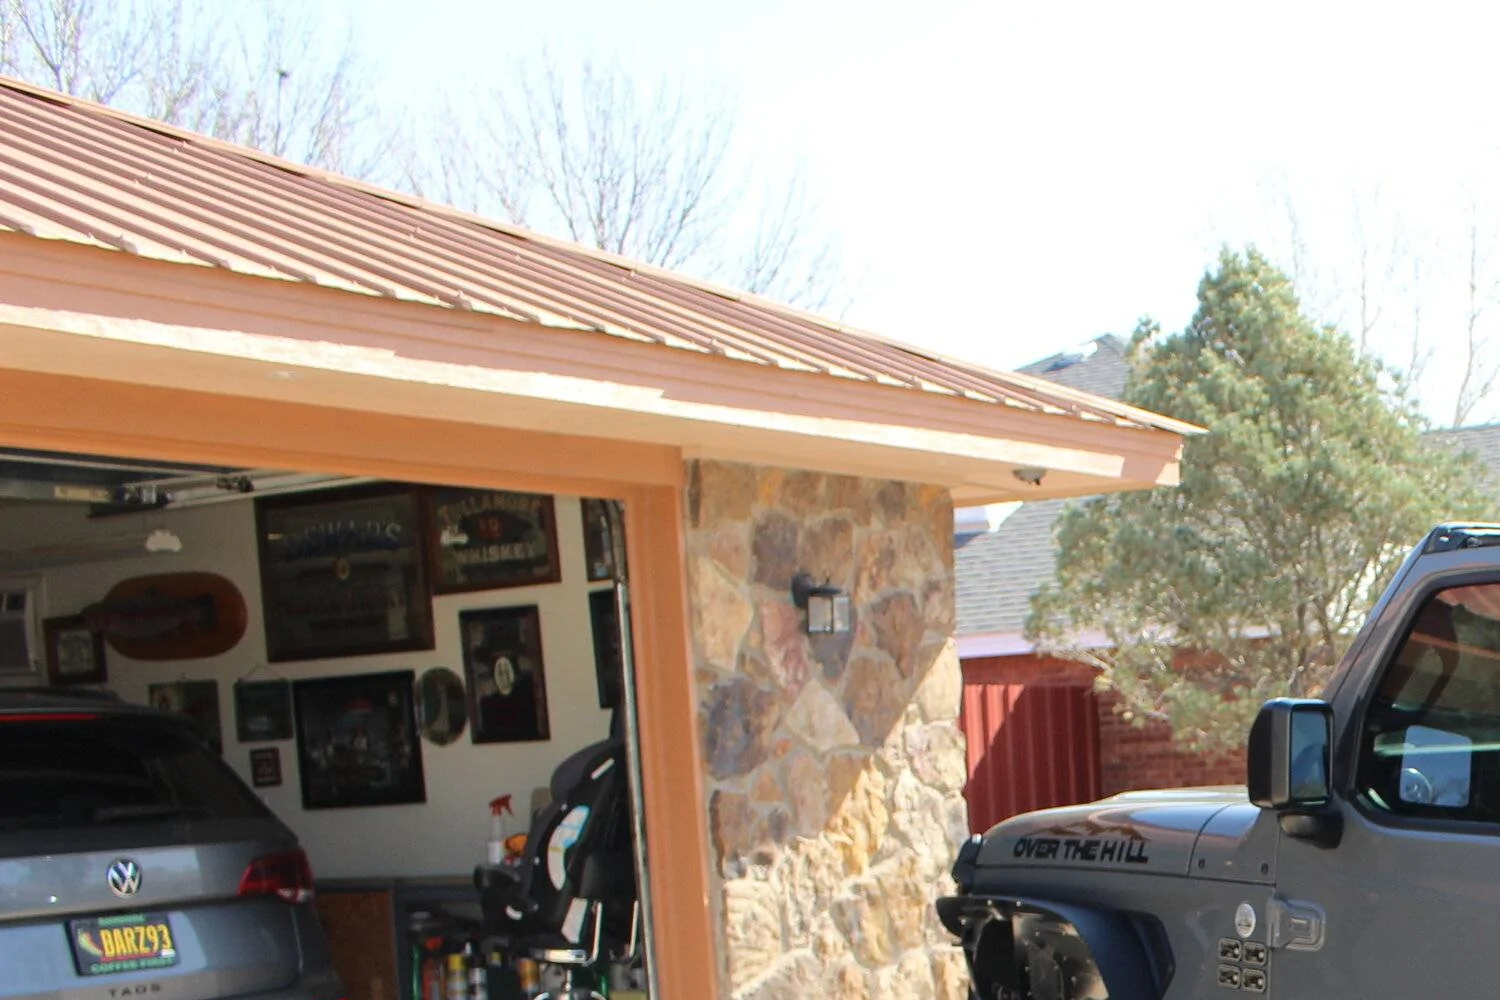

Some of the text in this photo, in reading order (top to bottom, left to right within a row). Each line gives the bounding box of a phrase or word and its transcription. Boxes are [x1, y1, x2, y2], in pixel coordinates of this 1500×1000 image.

[1013, 838, 1149, 864] OVER THE HILL
[109, 982, 161, 998] TAOS
